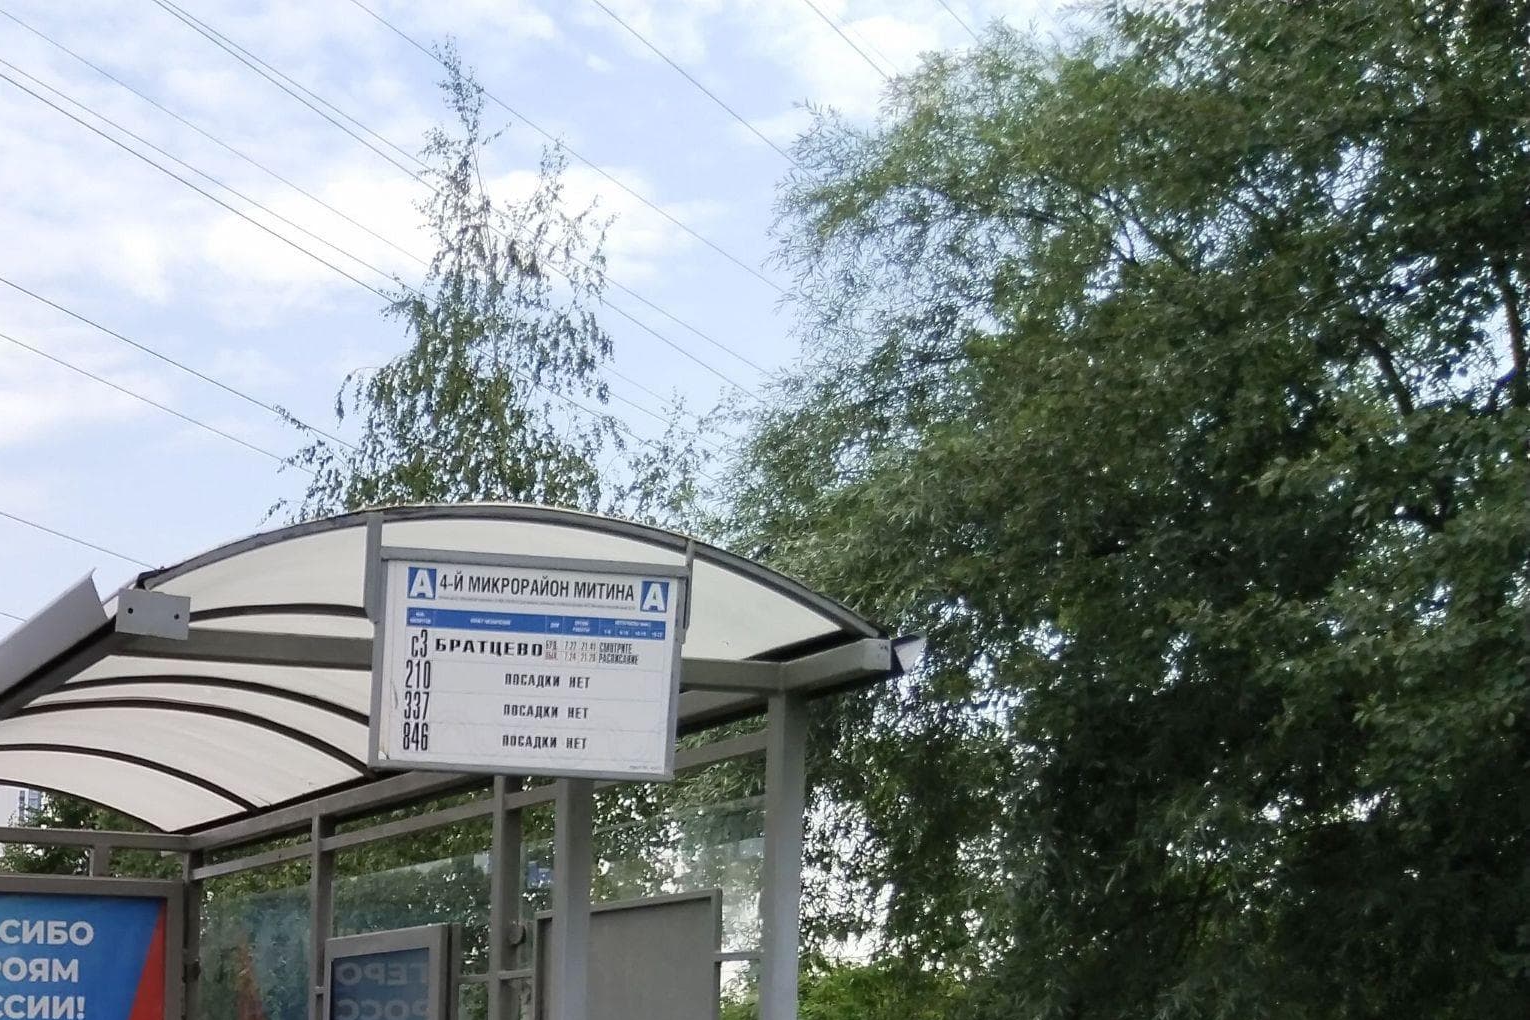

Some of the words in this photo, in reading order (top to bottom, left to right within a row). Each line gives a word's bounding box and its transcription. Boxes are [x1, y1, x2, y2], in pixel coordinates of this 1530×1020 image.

[439, 569, 464, 592] 4-Й
[468, 574, 569, 598] МИКРОРАЙОН
[573, 580, 635, 601] МИТИНА
[435, 638, 543, 657] БРАТЦЕВО
[598, 641, 633, 654] СМОТРИТЕ
[598, 653, 640, 665] РАСПИСАНИЕ
[405, 659, 431, 689] 210
[504, 673, 560, 688] ПОСАДКИ
[569, 676, 591, 689] НЕТ
[403, 691, 430, 720] 337
[503, 703, 559, 719] ПОСАДКИ
[567, 706, 589, 719] НЕТ
[403, 721, 429, 751] 846
[502, 734, 557, 749] ПОСАДКИ
[566, 737, 587, 750] НЕТ
